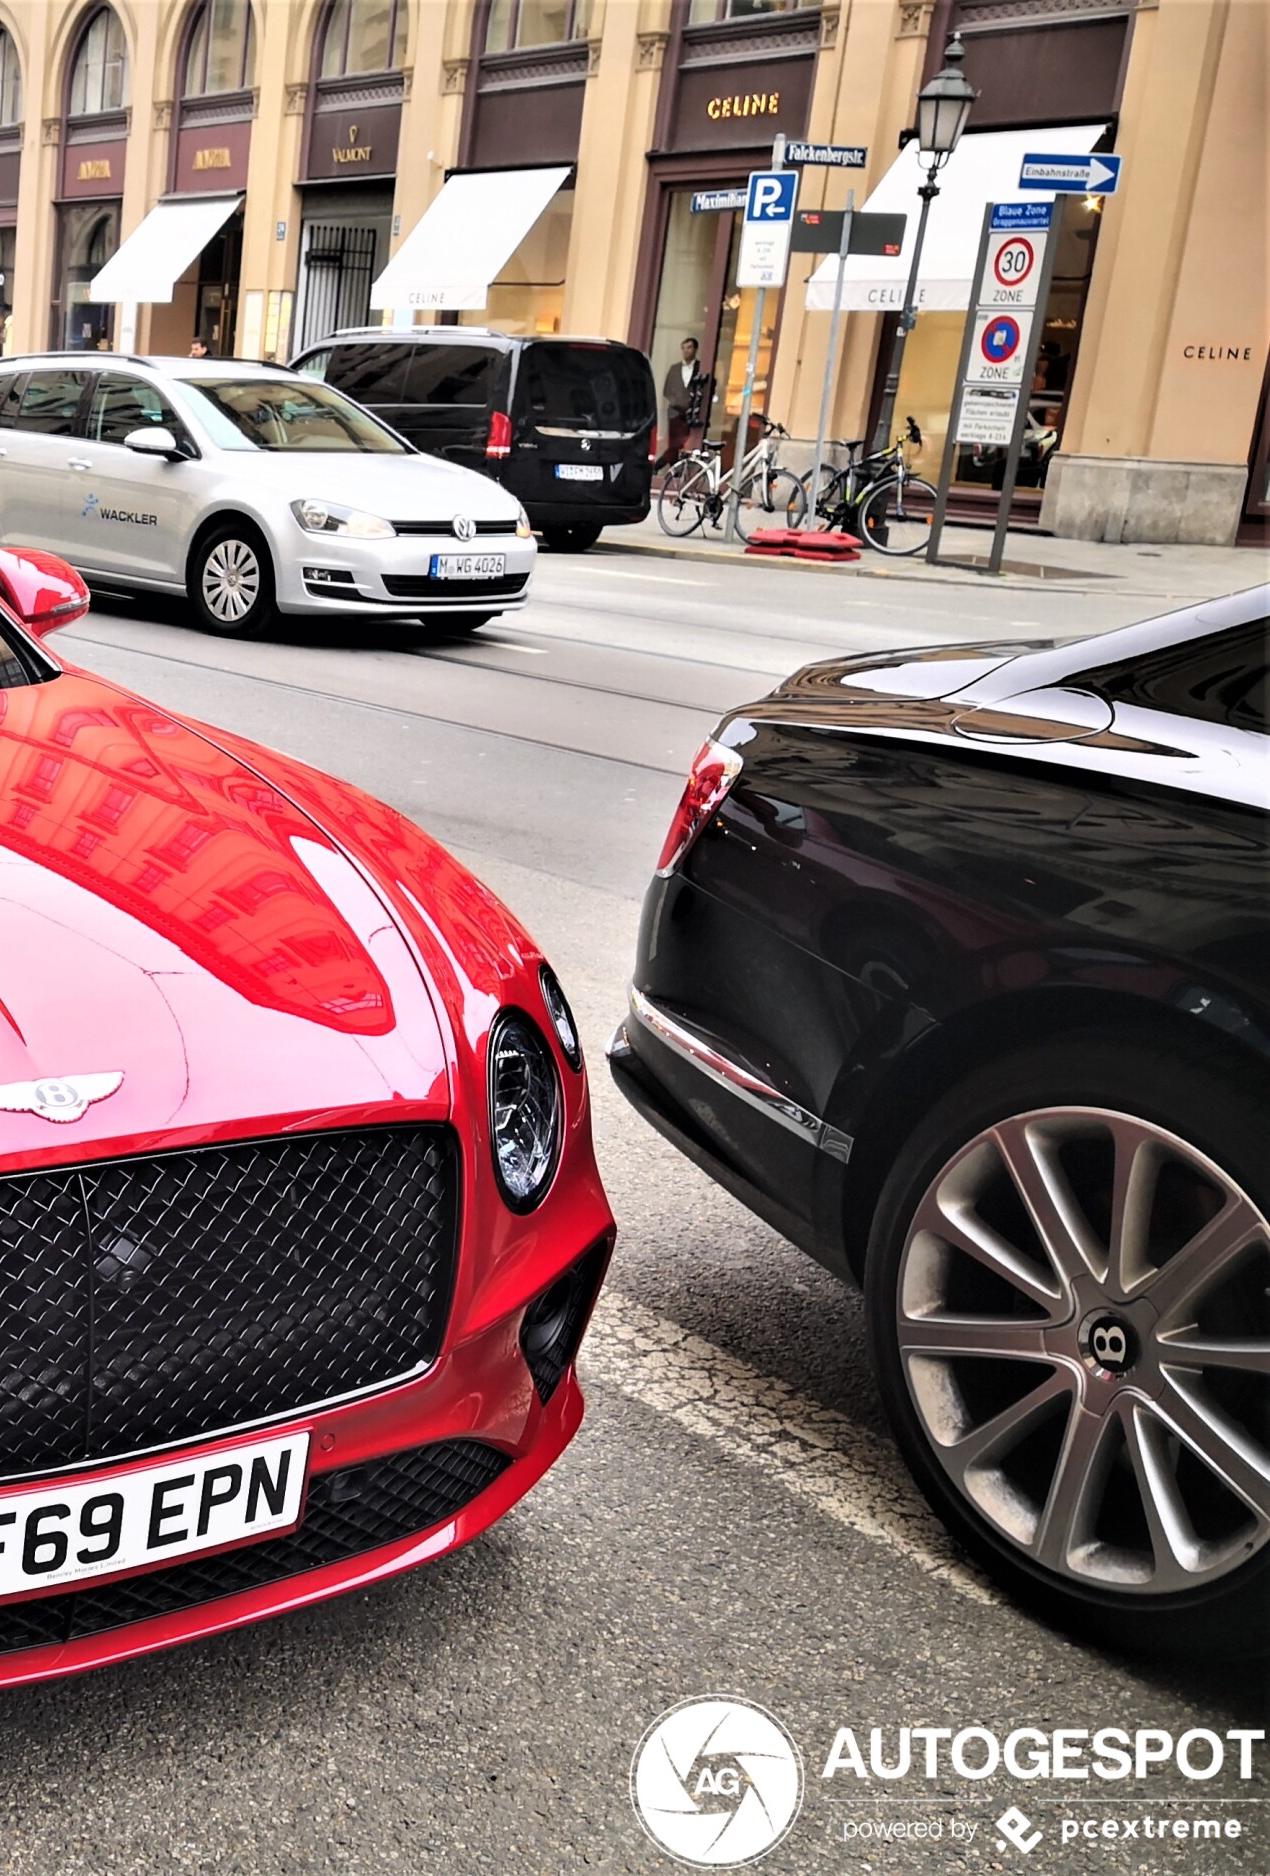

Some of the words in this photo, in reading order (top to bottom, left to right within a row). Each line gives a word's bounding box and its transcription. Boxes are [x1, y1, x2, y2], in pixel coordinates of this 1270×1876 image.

[707, 92, 779, 120] CELINE
[332, 146, 372, 163] VALMONT
[788, 144, 864, 166] Falckenbergstr.
[1025, 166, 1090, 179] Einbahnstraße
[752, 178, 783, 218] P
[998, 204, 1023, 217] Blaue
[1025, 204, 1047, 216] Zone
[1001, 251, 1026, 273] 30
[409, 291, 445, 304] CELINE
[867, 289, 926, 304] CELIE
[992, 289, 1023, 303] ZONE
[1183, 345, 1251, 361] CELINE
[979, 366, 1010, 381] ZONE
[100, 508, 158, 526] WACKLER
[474, 558, 503, 574] 4026
[146, 1448, 292, 1550] EPN
